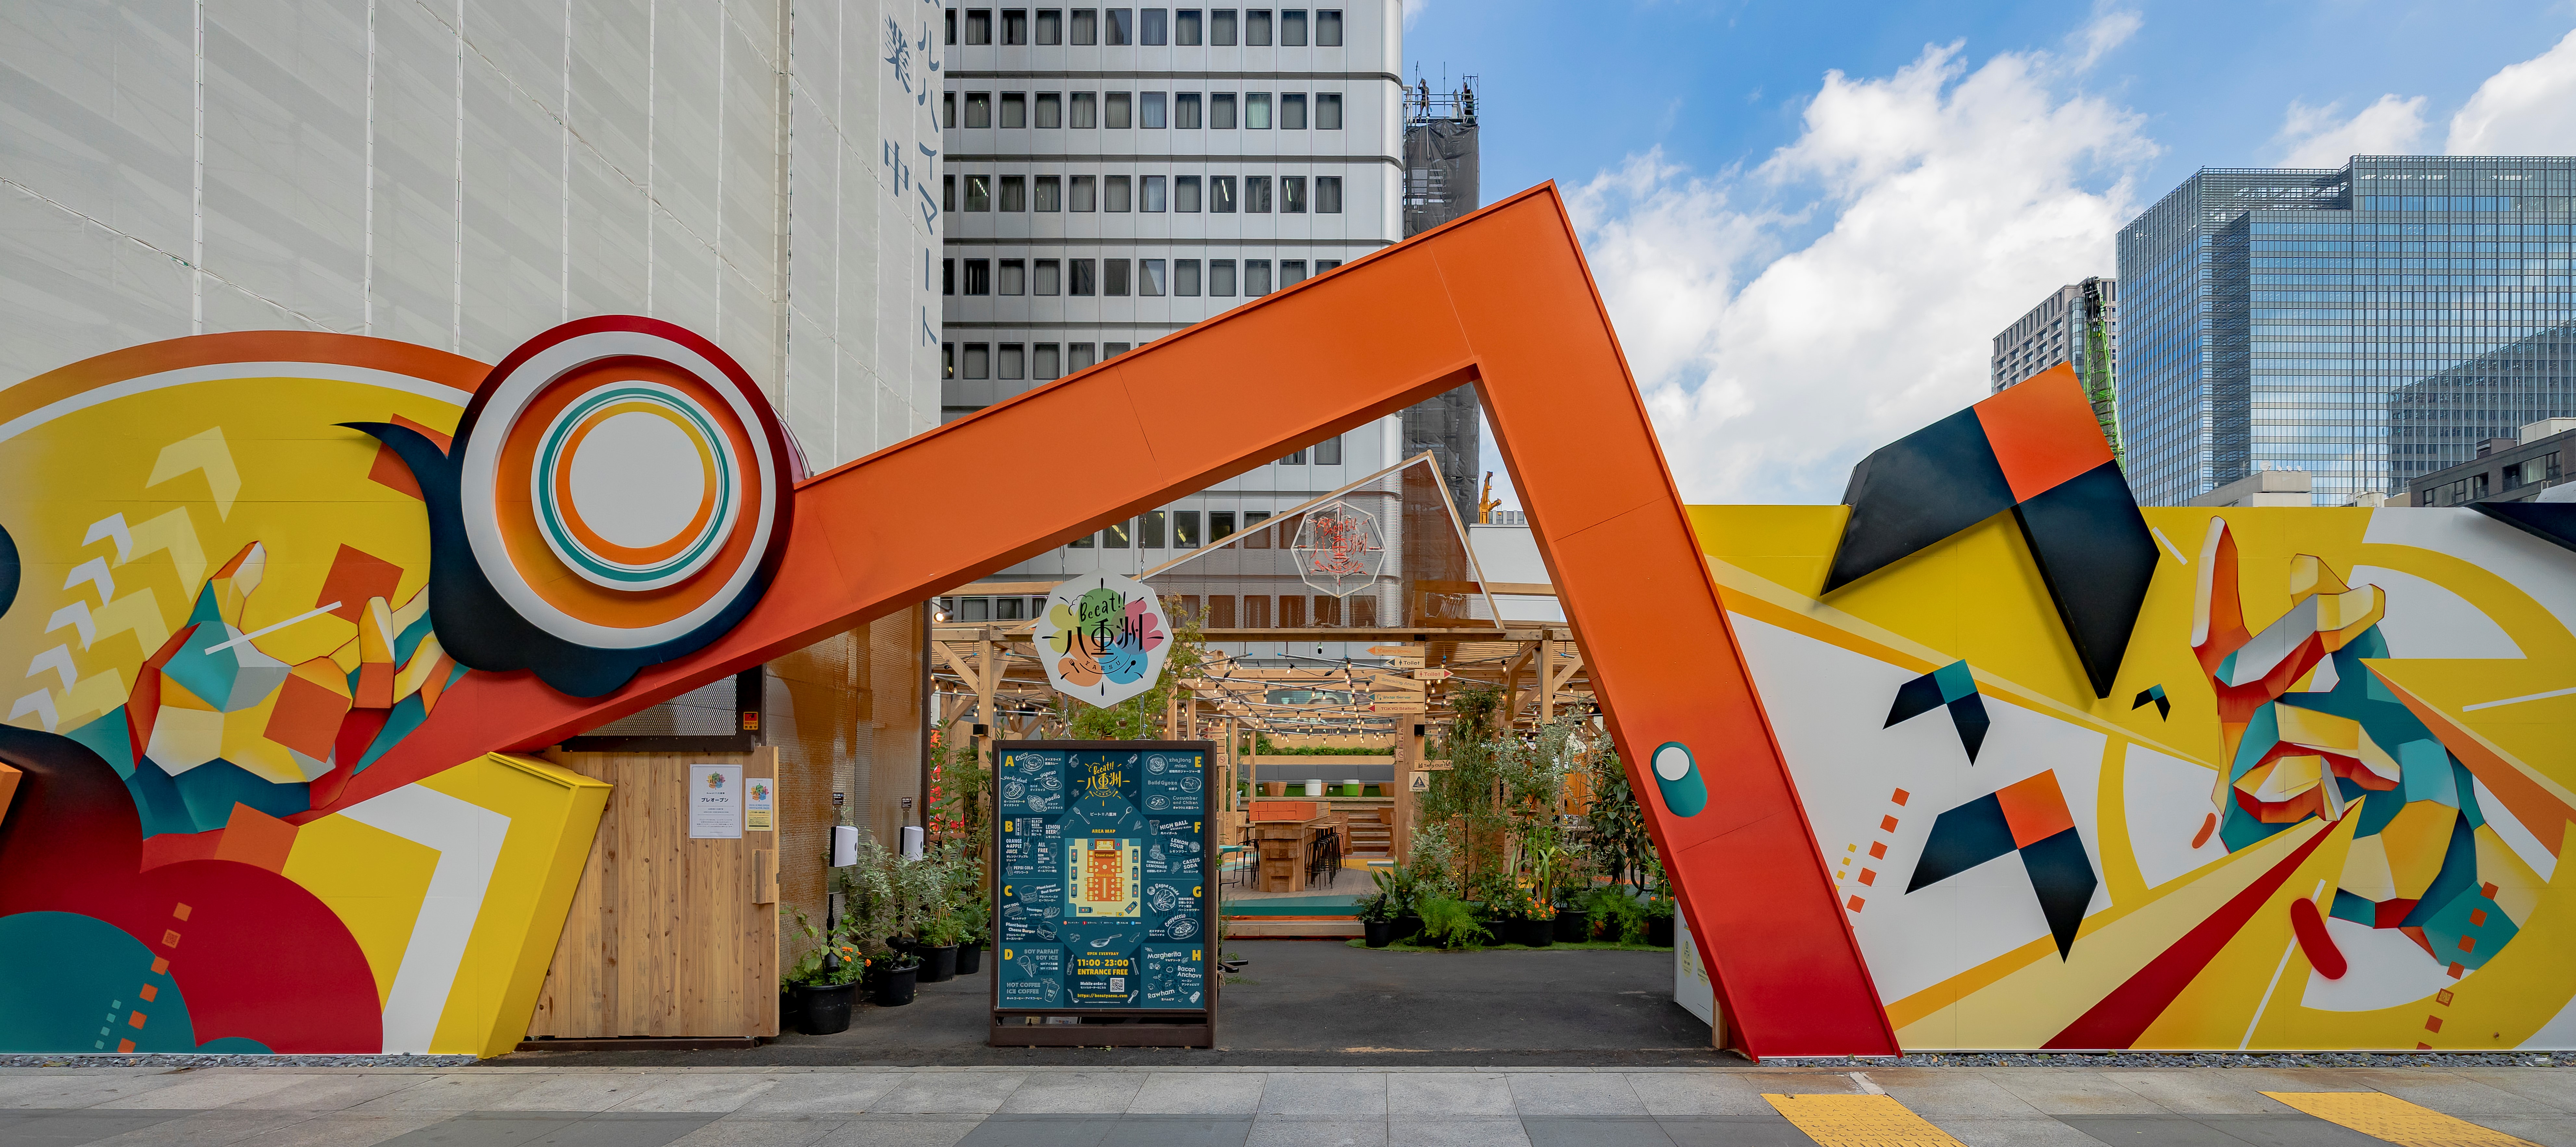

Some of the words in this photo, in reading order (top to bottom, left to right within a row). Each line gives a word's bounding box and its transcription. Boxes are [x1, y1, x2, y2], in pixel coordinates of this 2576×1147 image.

[918, 0, 939, 347] ルハイマート
[1060, 614, 1143, 660] 八重洲
[1085, 660, 1121, 671] YAESU
[1005, 756, 1014, 767] A
[1195, 756, 1201, 767] E
[1085, 771, 1121, 791] 八重洲
[1005, 821, 1013, 832] B
[1194, 822, 1201, 833] F
[1004, 885, 1012, 896] C
[1193, 886, 1201, 897] G
[1005, 949, 1013, 960] D
[1192, 950, 1201, 960] H
[1148, 989, 1175, 999] Rawham
